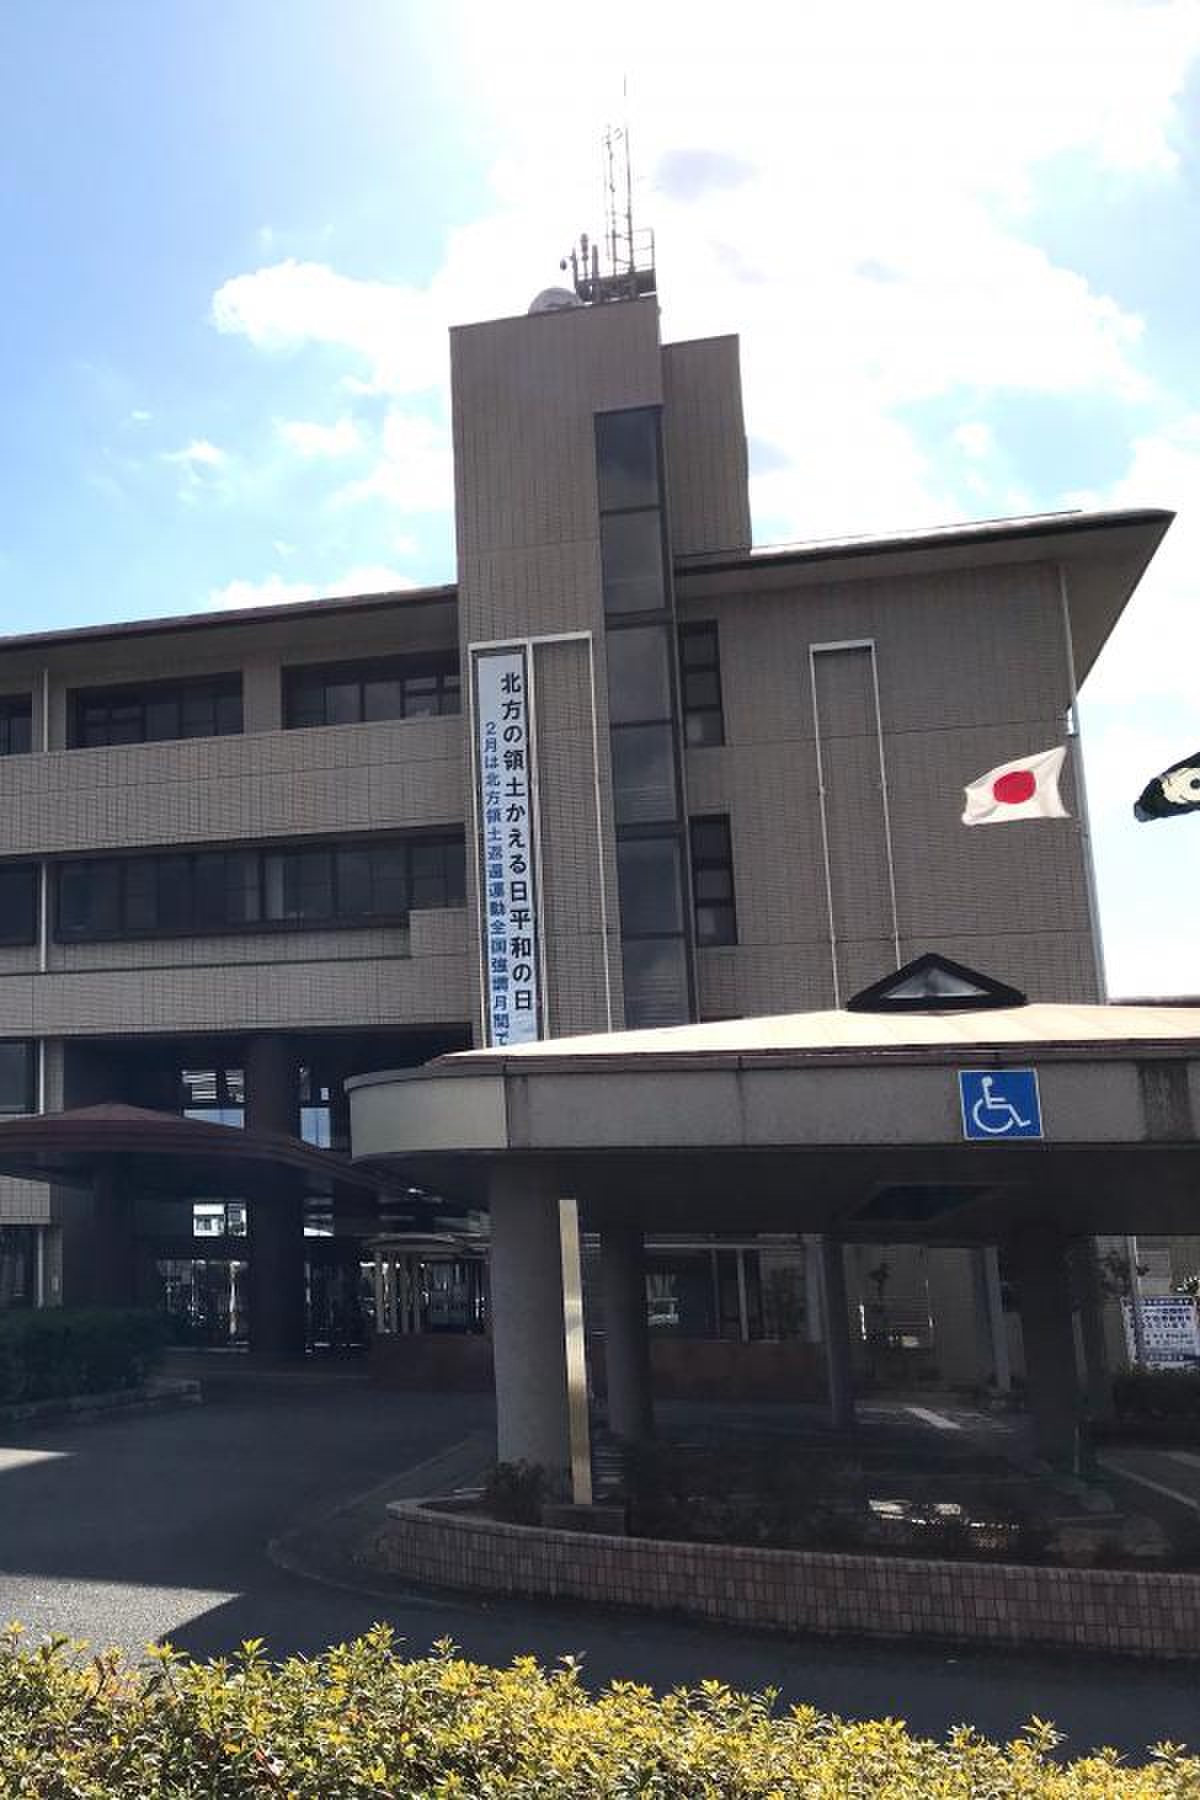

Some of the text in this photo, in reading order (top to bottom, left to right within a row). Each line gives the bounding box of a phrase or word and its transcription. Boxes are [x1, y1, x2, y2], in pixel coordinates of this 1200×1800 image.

[501, 672, 533, 1011] 北方の領土かえる日平和の日
